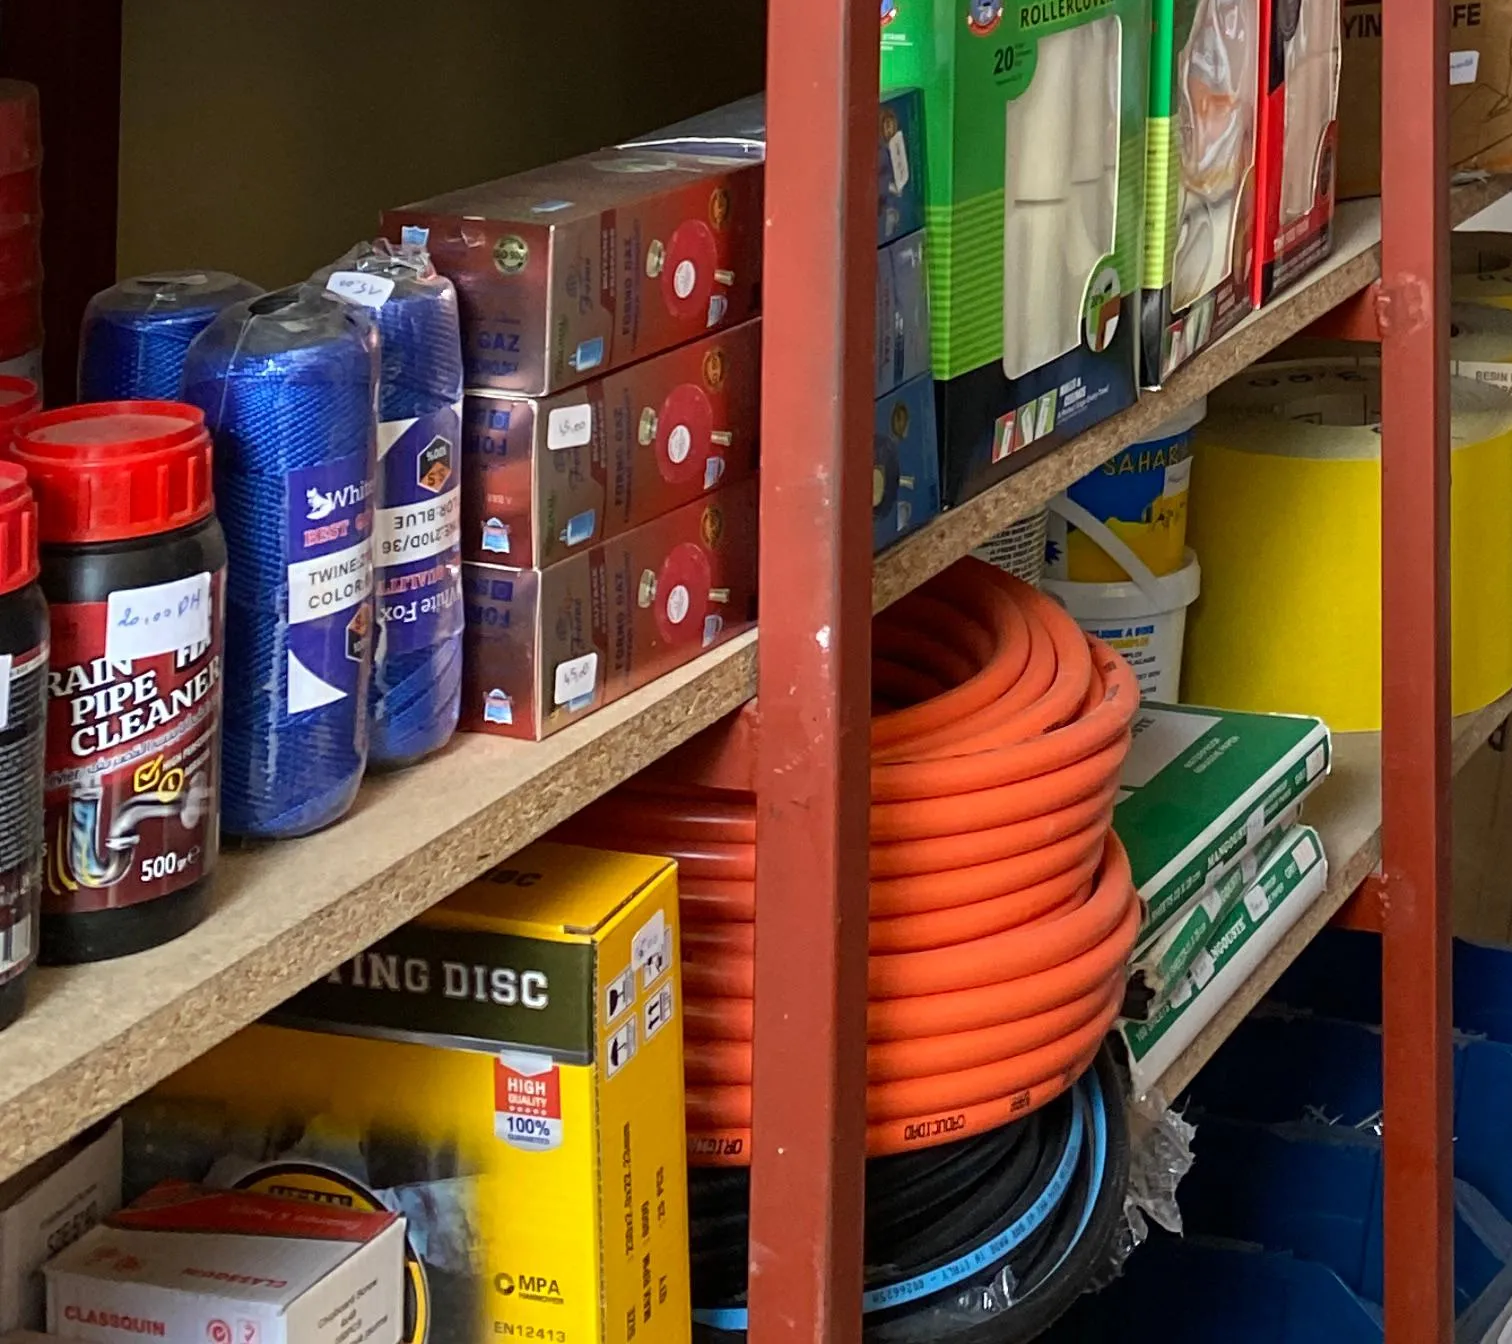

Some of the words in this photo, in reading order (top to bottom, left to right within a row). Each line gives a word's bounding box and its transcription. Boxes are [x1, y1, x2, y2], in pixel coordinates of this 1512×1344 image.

[994, 46, 1014, 75] 20
[480, 334, 521, 353] GAZ
[1476, 370, 1508, 383] RESIN
[304, 519, 350, 548] BEST
[177, 588, 203, 619] DH
[379, 601, 418, 624] Fox
[71, 670, 158, 726] PIPE
[71, 655, 222, 758] CLEANER
[443, 960, 549, 1010] DISC
[507, 1078, 547, 1097] HIGH
[507, 1094, 547, 1108] QUALITY
[505, 1115, 550, 1138] 100%
[517, 1273, 561, 1297] MPA
[64, 1304, 166, 1337] CLASSQUIN
[494, 1320, 567, 1343] EN12413
